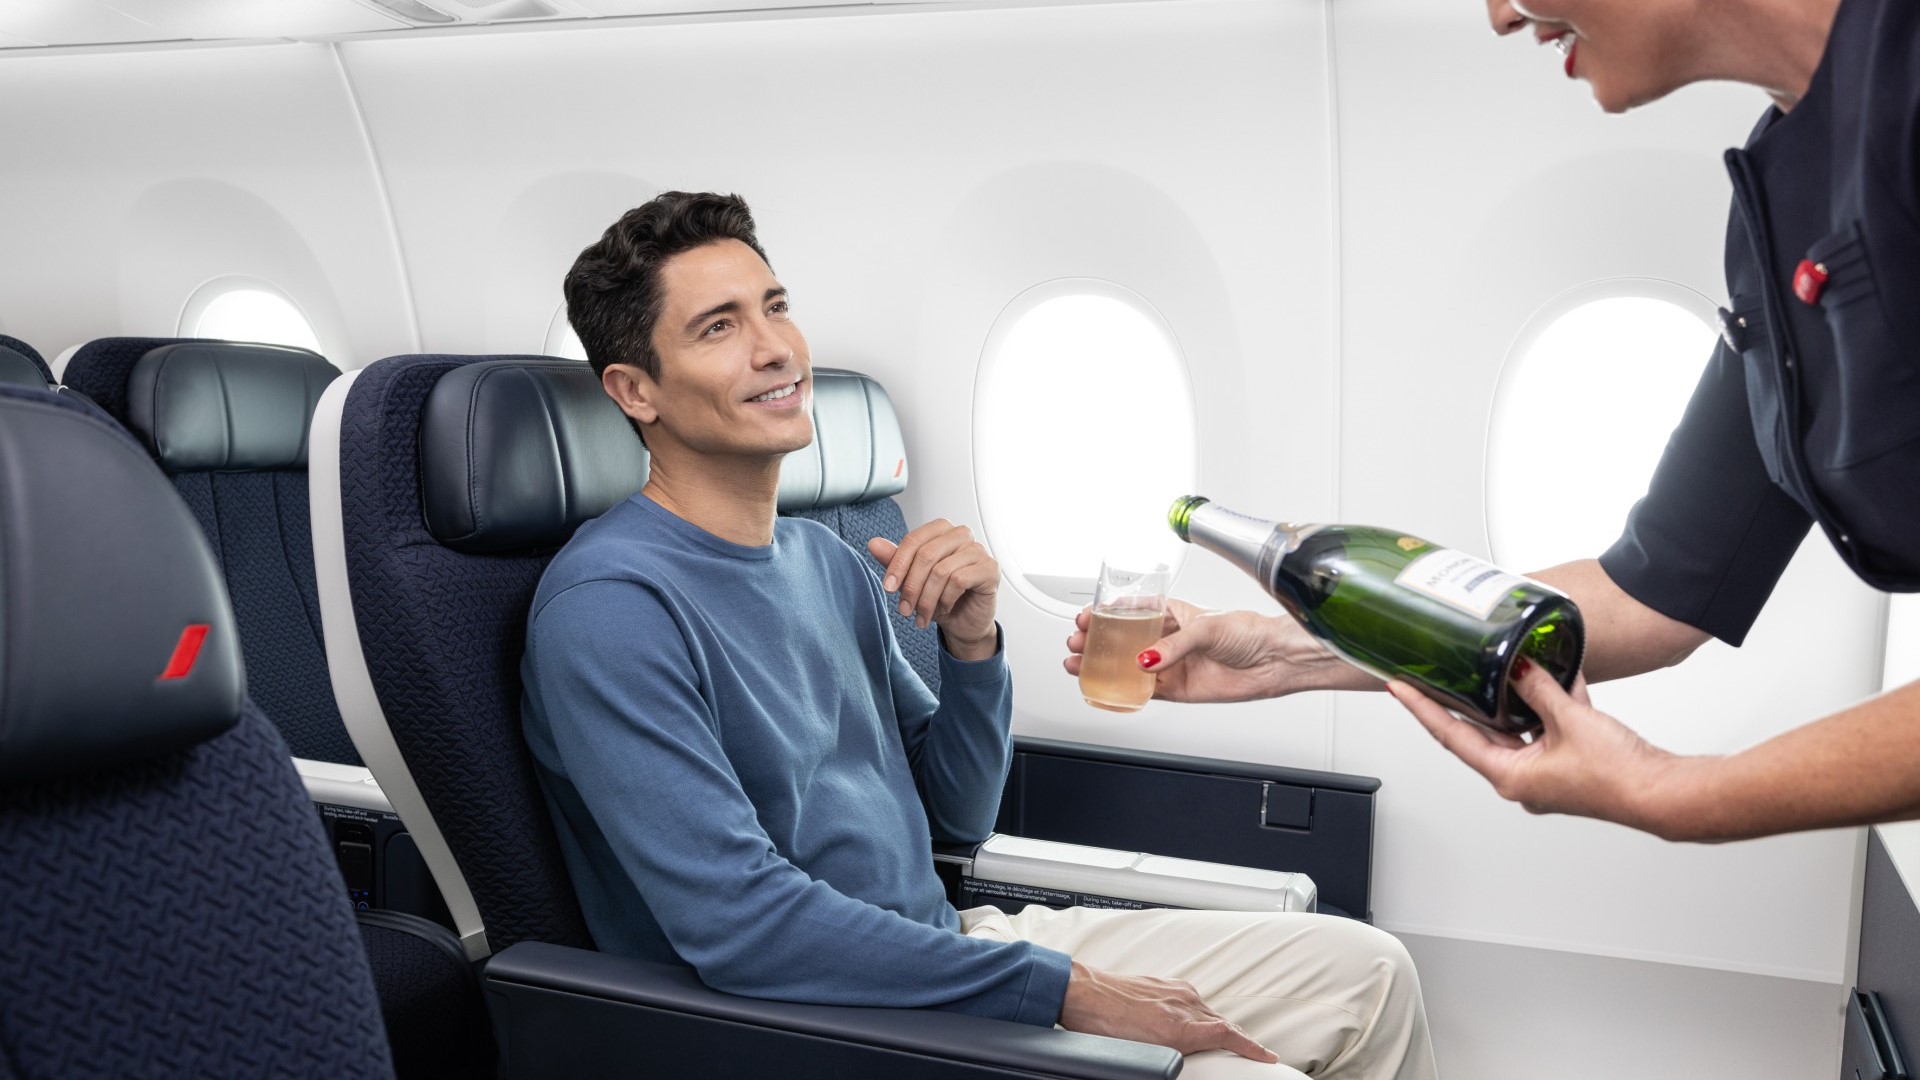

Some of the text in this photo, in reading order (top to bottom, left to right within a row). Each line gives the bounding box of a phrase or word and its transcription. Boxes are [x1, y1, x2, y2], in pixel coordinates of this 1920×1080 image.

[1012, 886, 1034, 894] décollage
[1040, 890, 1071, 900] l'atterrissage,
[1013, 892, 1046, 901] télécommande
